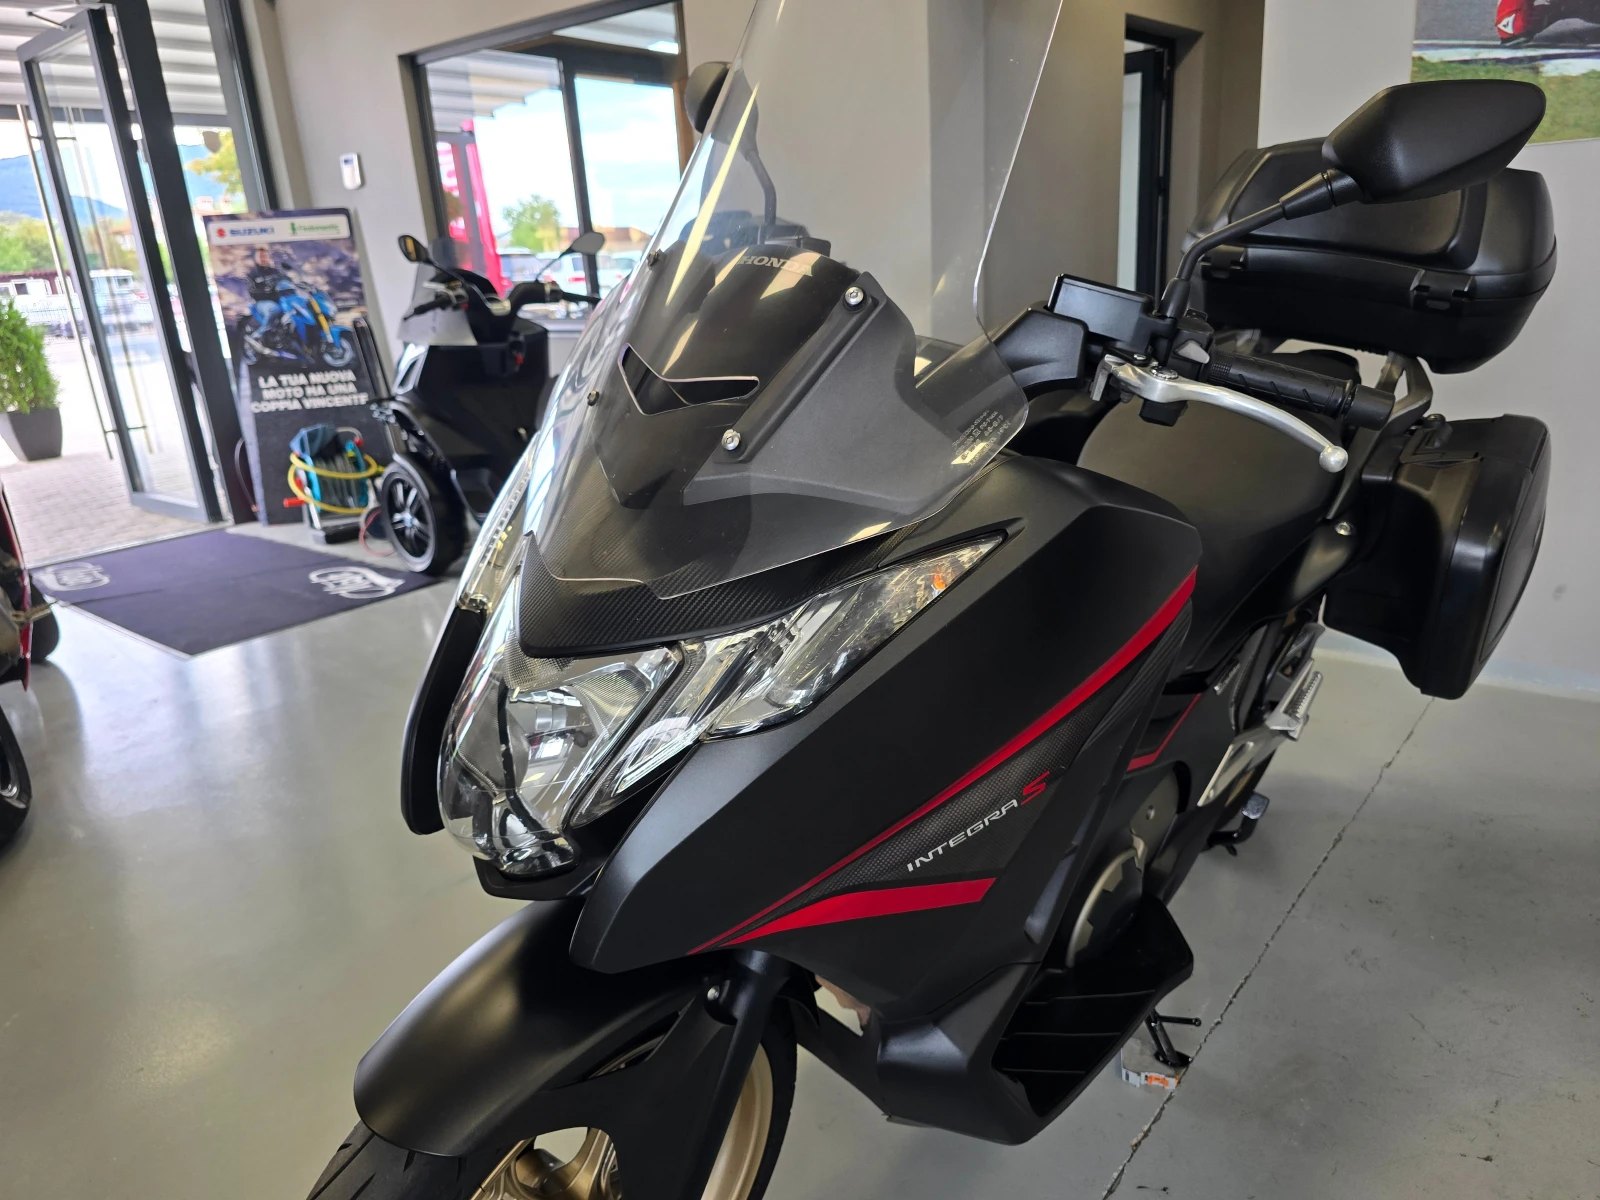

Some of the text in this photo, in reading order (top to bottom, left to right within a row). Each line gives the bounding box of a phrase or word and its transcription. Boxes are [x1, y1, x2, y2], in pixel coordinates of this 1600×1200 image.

[229, 226, 275, 237] SUZUKI
[738, 255, 813, 277] HONDA
[258, 369, 357, 388] LA TUA NUOVA
[262, 382, 358, 400] MOTO HA UNA
[250, 392, 369, 413] COPPIA VINCENTE
[907, 771, 1050, 872] INTEGRA S
